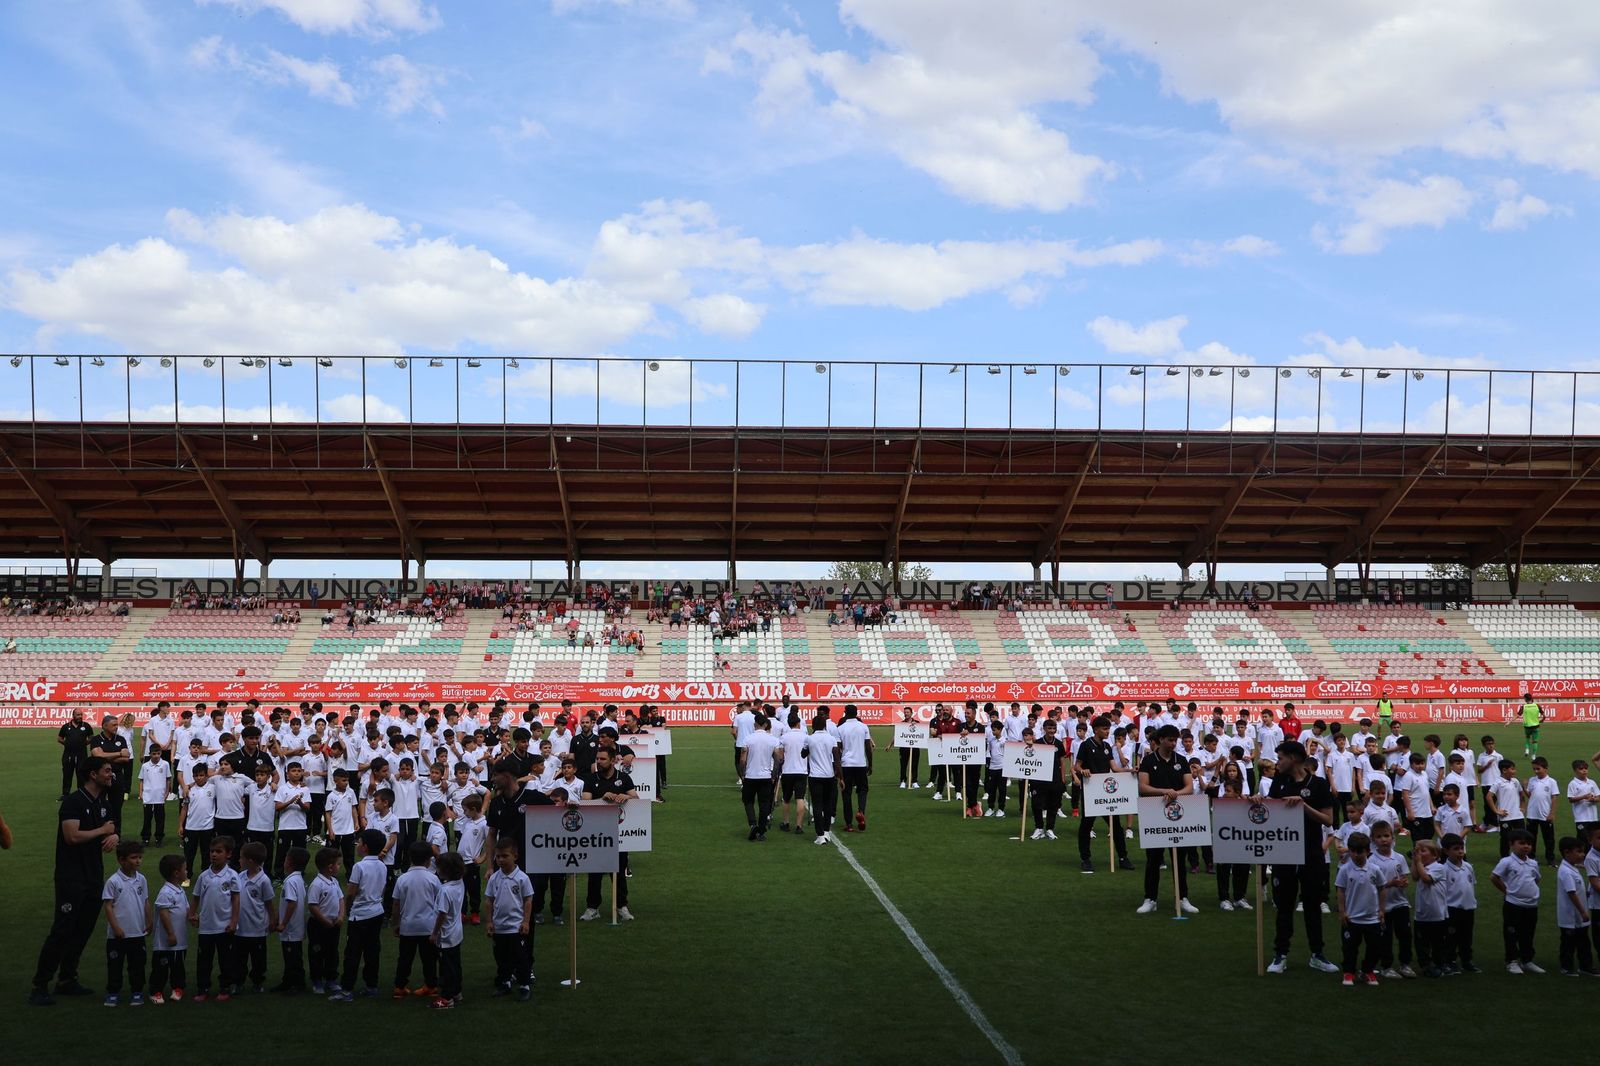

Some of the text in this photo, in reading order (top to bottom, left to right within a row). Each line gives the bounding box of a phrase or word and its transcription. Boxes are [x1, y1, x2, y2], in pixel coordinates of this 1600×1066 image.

[113, 578, 261, 599] ESTADIO
[1122, 581, 1166, 601] DE
[1175, 582, 1327, 601] ZAMORA
[32, 682, 57, 701] CF
[684, 682, 811, 700] CAJA RURAL
[919, 683, 996, 693] recoletas salud
[1120, 687, 1138, 695] tres
[1252, 682, 1306, 694] industrial
[1459, 685, 1511, 693] leomotor.net
[1532, 681, 1578, 691] ZAMORA
[22, 708, 33, 719] DE
[36, 708, 47, 719] LA
[661, 708, 716, 721] FEDERACIÓN
[1428, 703, 1484, 722] La Opinión
[1500, 704, 1513, 718] La
[1573, 703, 1585, 717] La
[1222, 714, 1233, 722] DE
[1014, 757, 1043, 767] Alevín
[1094, 796, 1129, 805] BENJAMÍN
[1144, 824, 1206, 835] PREBENJAMÍN
[1218, 826, 1299, 844] Chupetín
[531, 833, 614, 851] Chupetín
